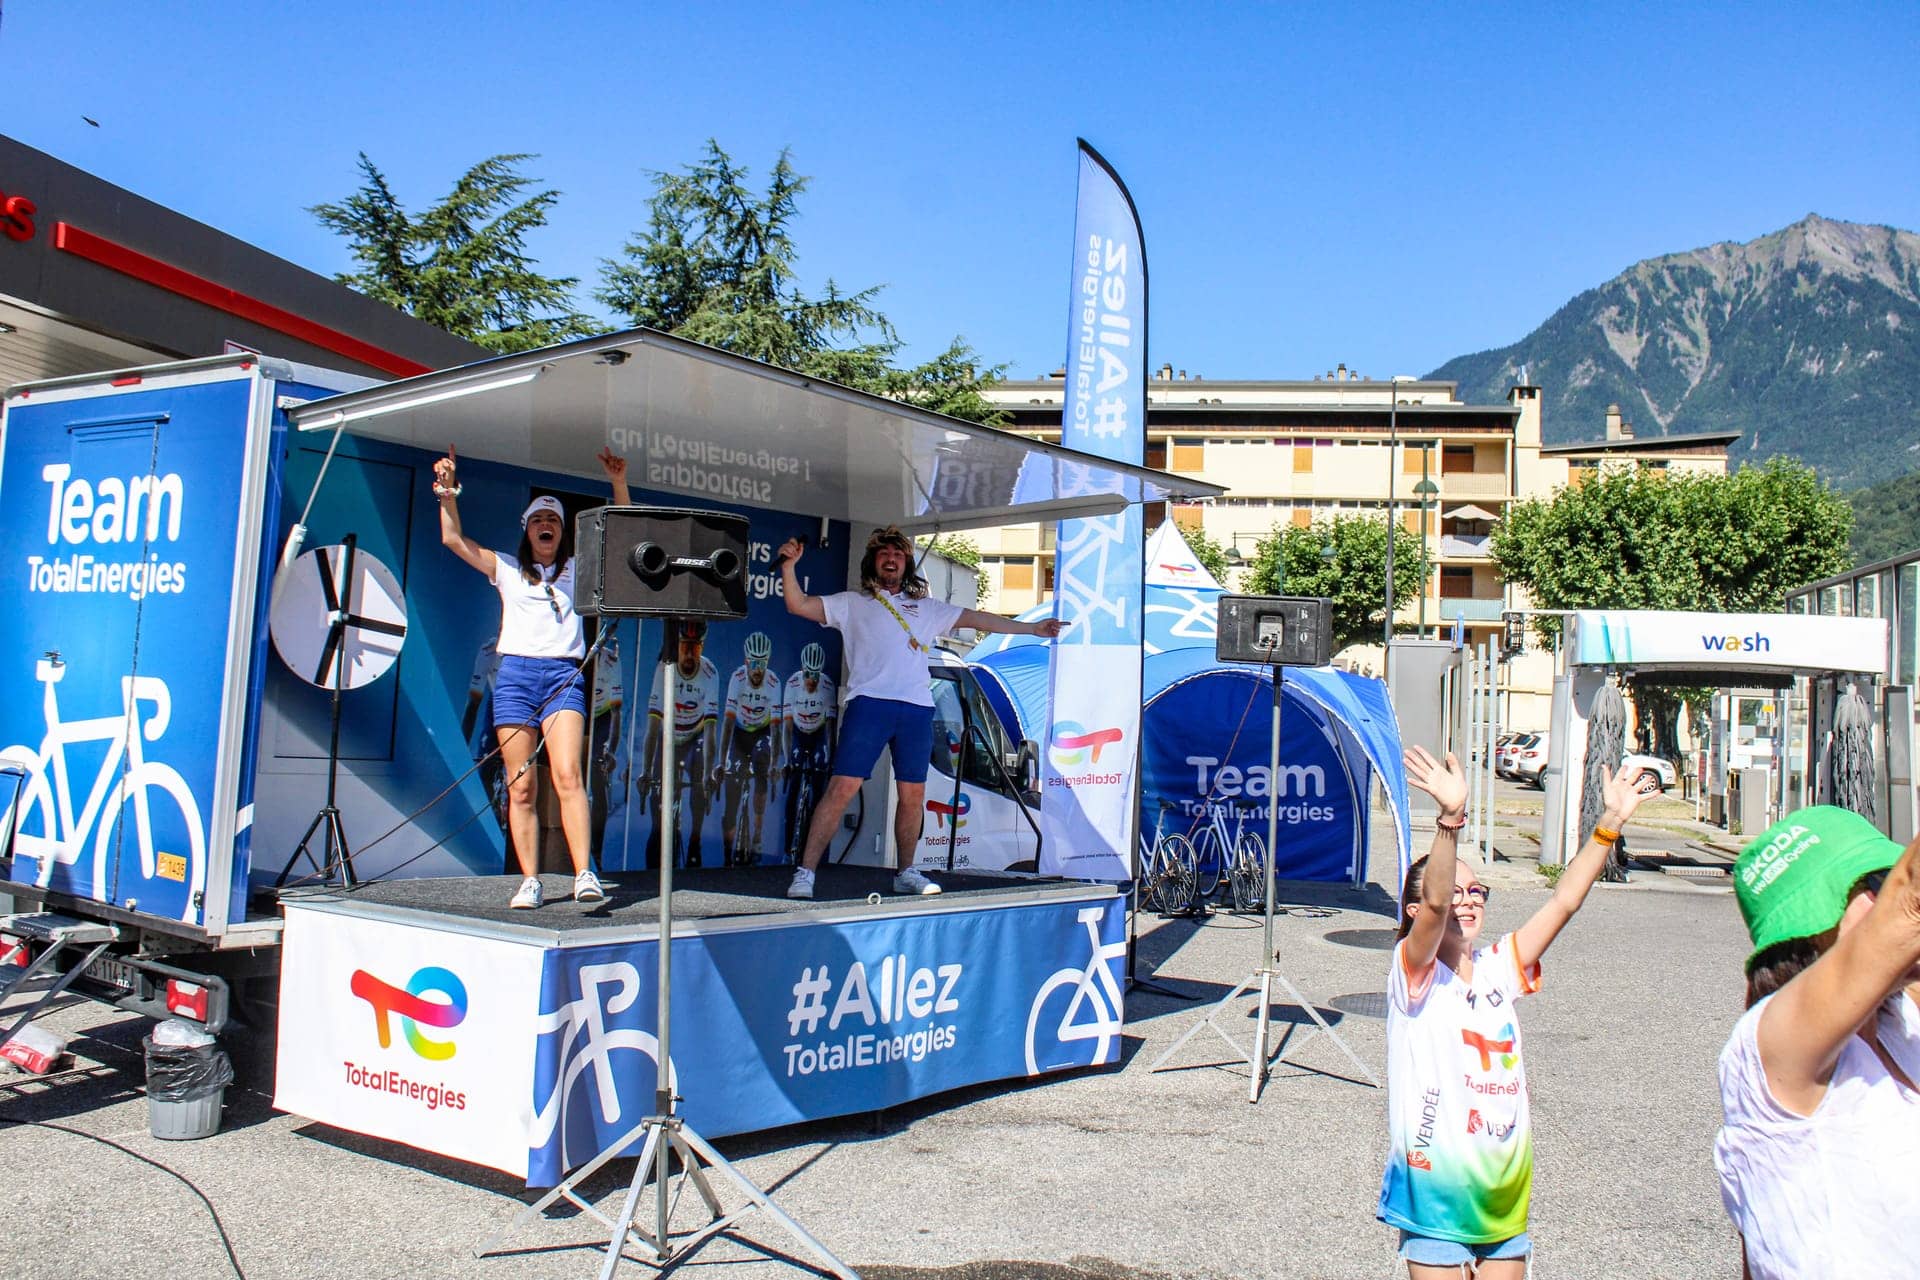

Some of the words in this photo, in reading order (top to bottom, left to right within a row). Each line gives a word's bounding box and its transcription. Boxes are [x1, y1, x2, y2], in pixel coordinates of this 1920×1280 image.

[42, 463, 184, 545] Team
[27, 553, 187, 601] TotalEnergies
[1701, 631, 1770, 652] wash
[1185, 756, 1326, 798] Team
[787, 954, 963, 1037] #Allez
[783, 1022, 957, 1077] TotalEnergies
[343, 1061, 466, 1110] TotalEnergies
[1414, 1086, 1441, 1148] VENDÉE
